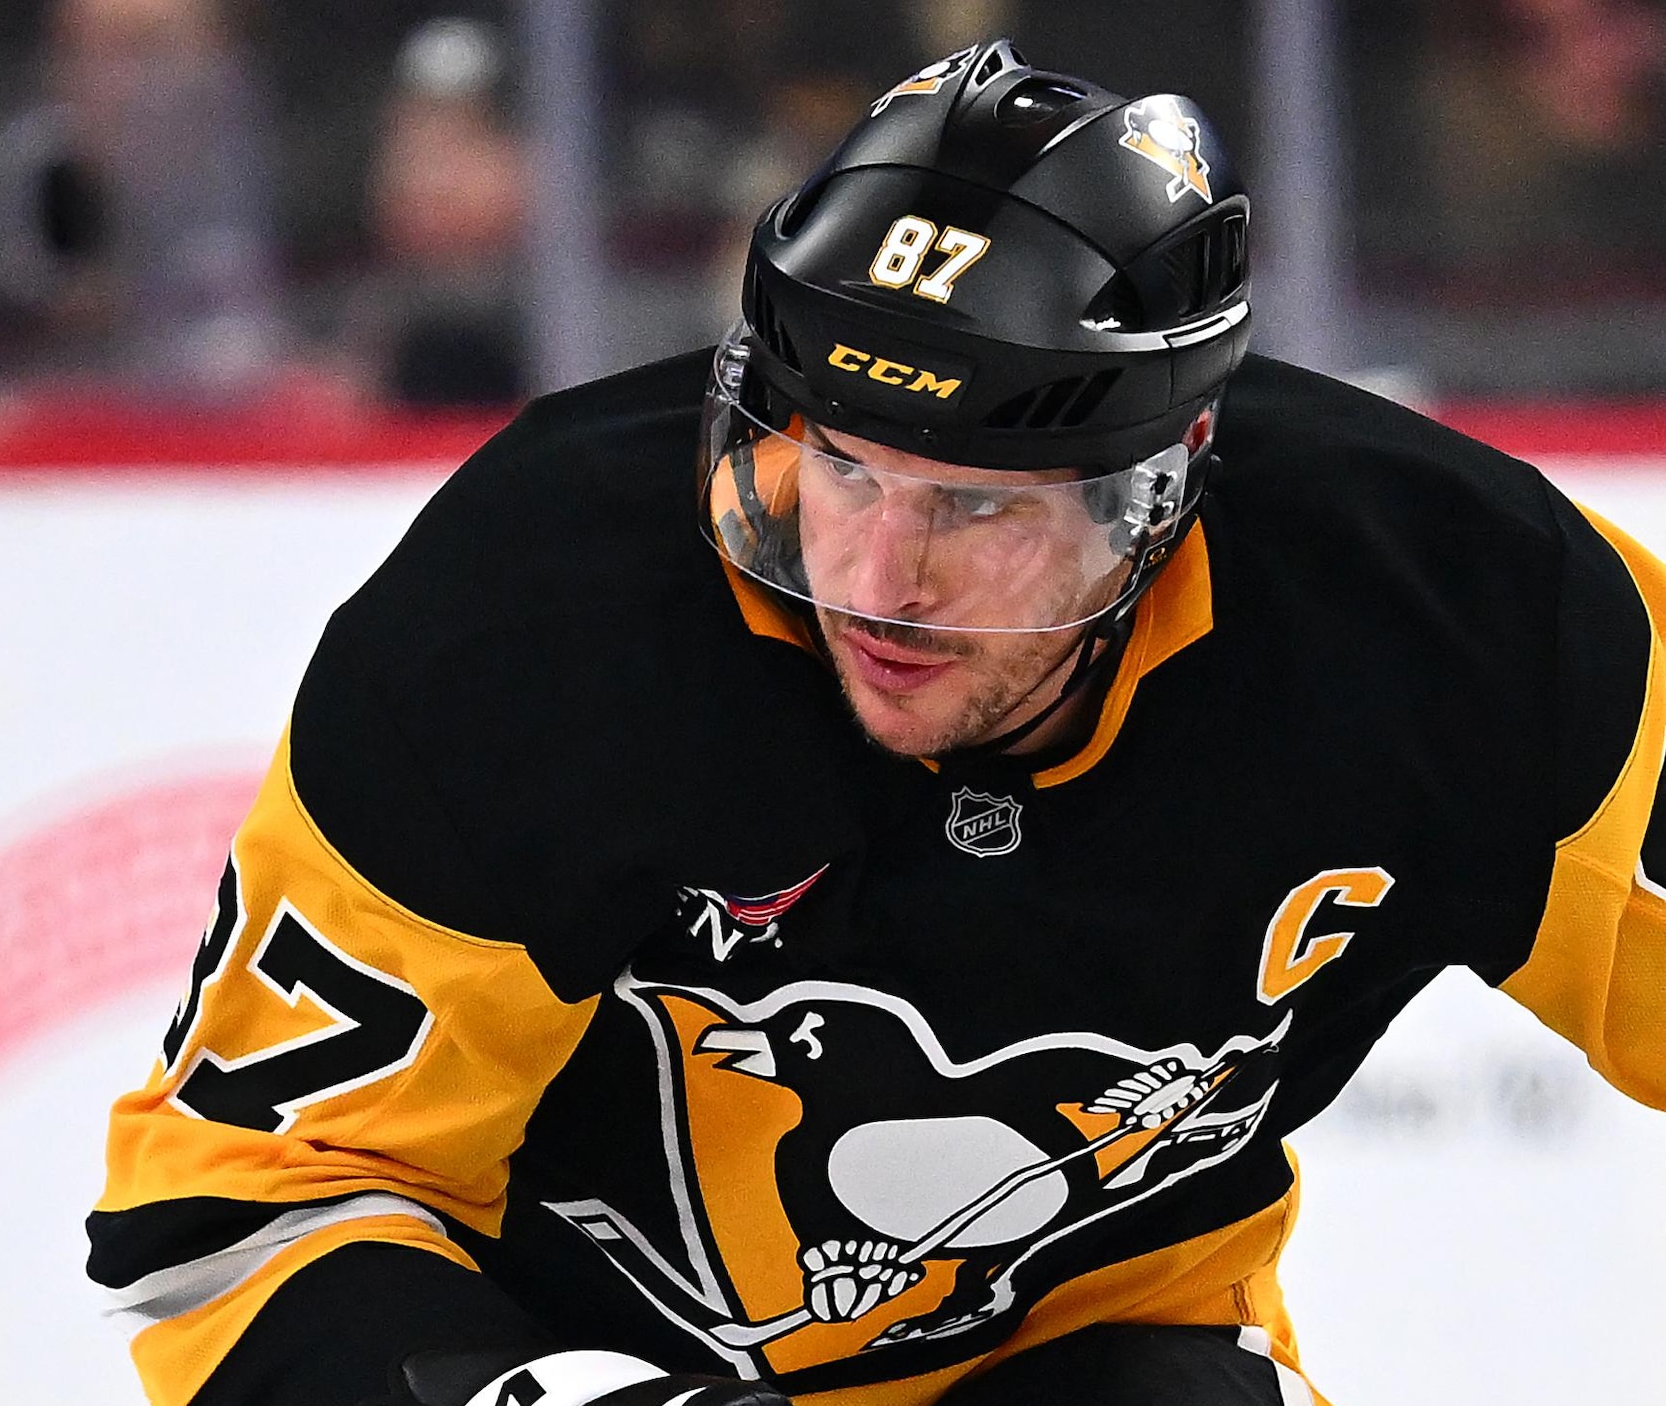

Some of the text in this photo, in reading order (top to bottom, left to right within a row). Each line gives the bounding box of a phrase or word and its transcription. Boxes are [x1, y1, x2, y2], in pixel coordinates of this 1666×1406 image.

[868, 214, 991, 303] 87
[828, 343, 963, 399] CCM
[963, 812, 1007, 839] NHL
[1257, 866, 1396, 1006] C
